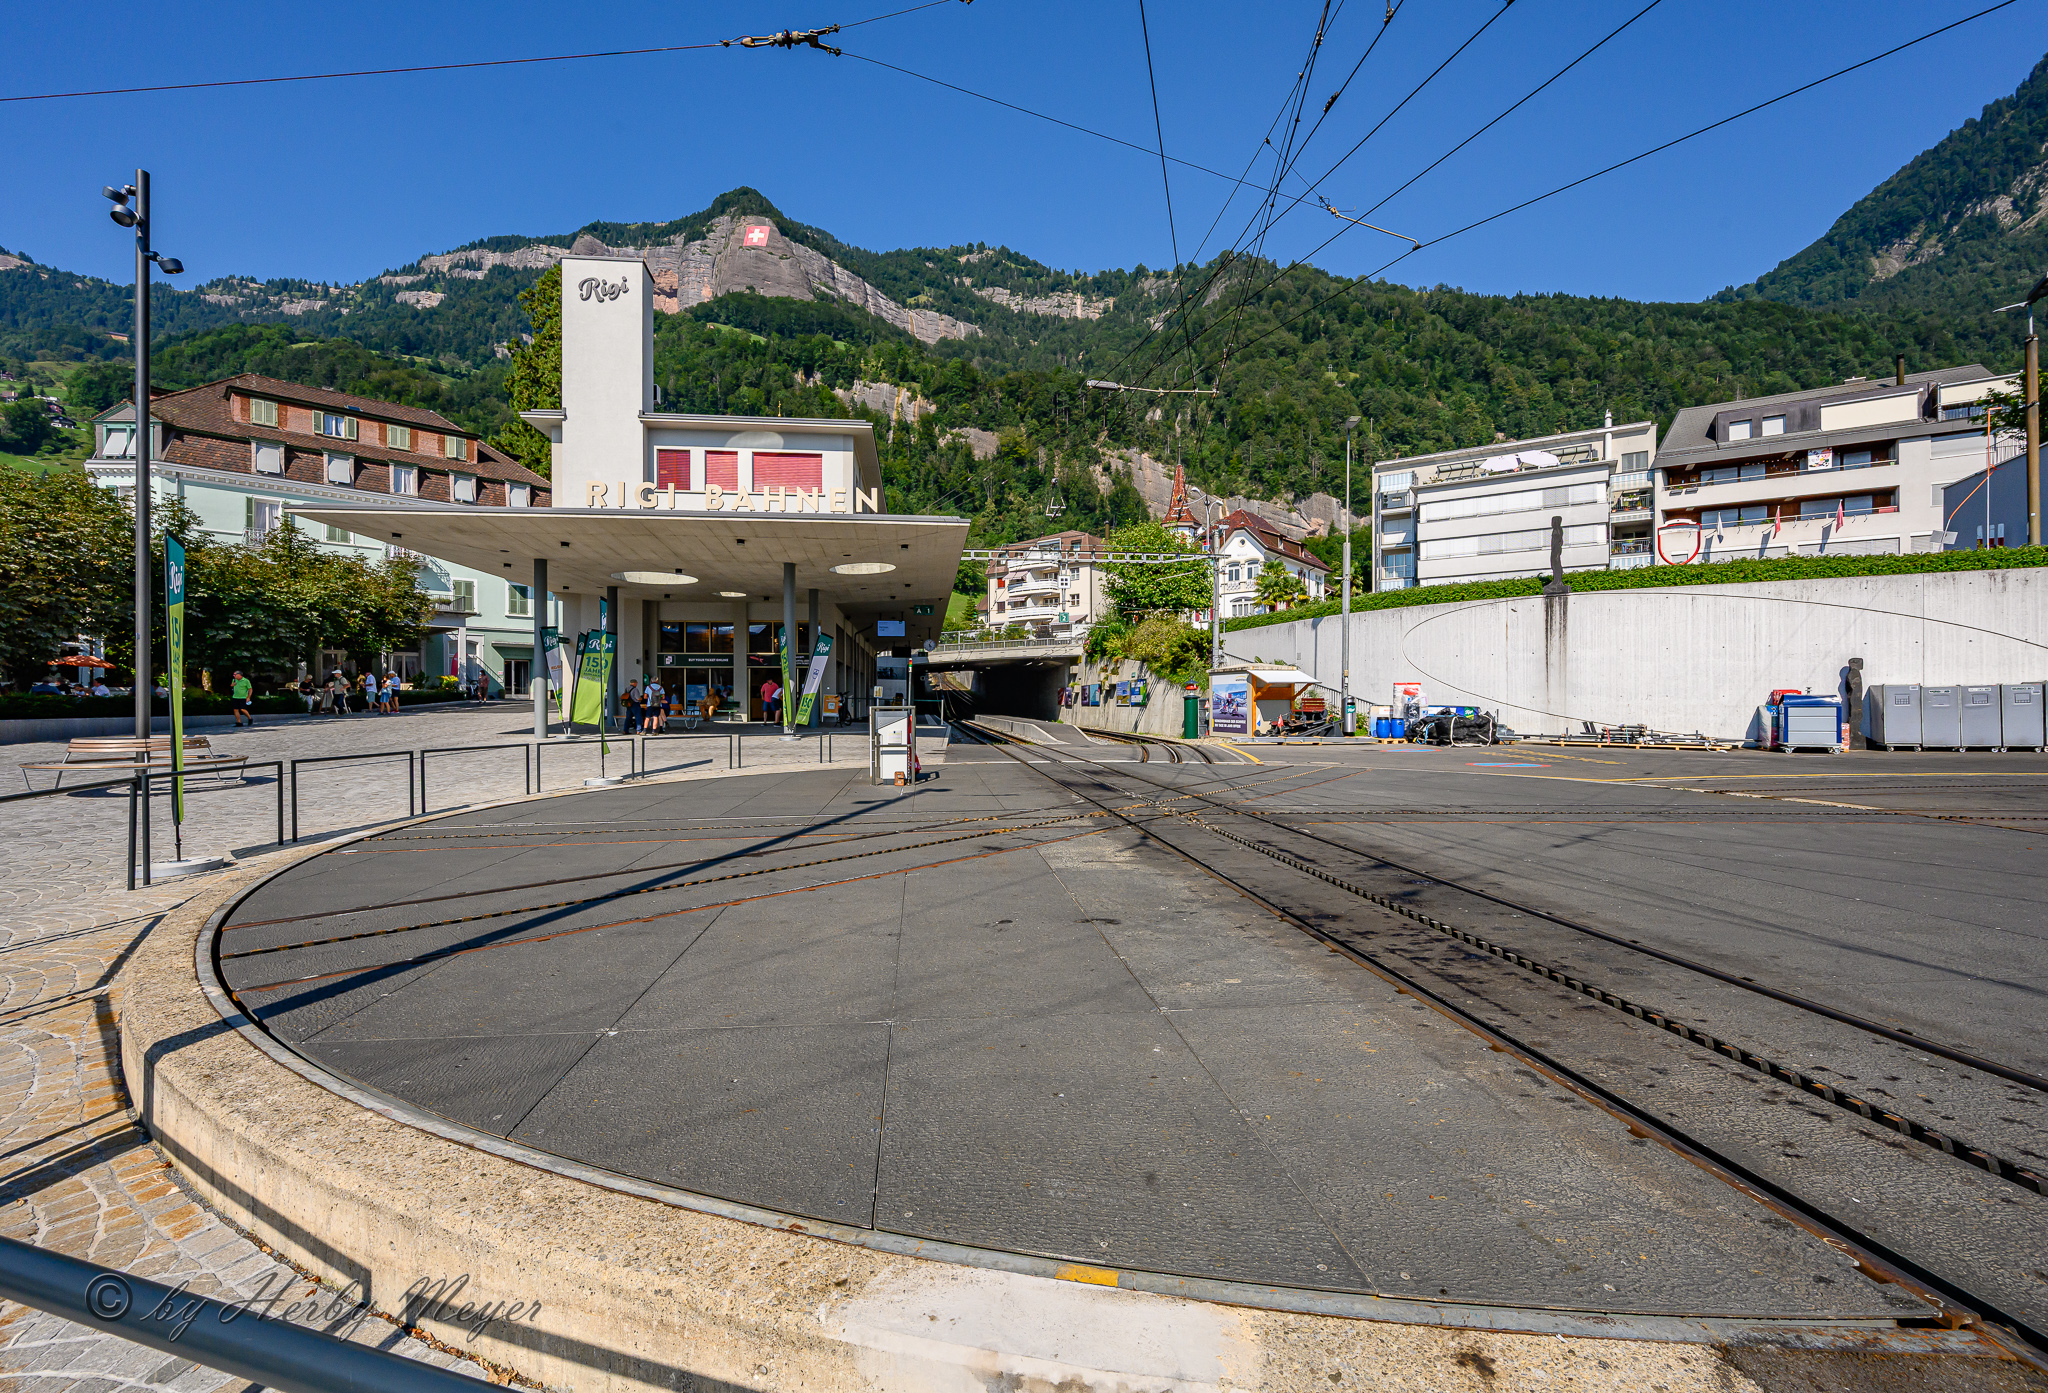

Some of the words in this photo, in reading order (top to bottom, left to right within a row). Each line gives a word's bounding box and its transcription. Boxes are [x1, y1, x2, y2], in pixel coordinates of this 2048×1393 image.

[578, 275, 630, 303] Rigi
[586, 480, 676, 510] RIGI
[705, 483, 878, 514] BAHNEN
[169, 561, 183, 594] Rigi
